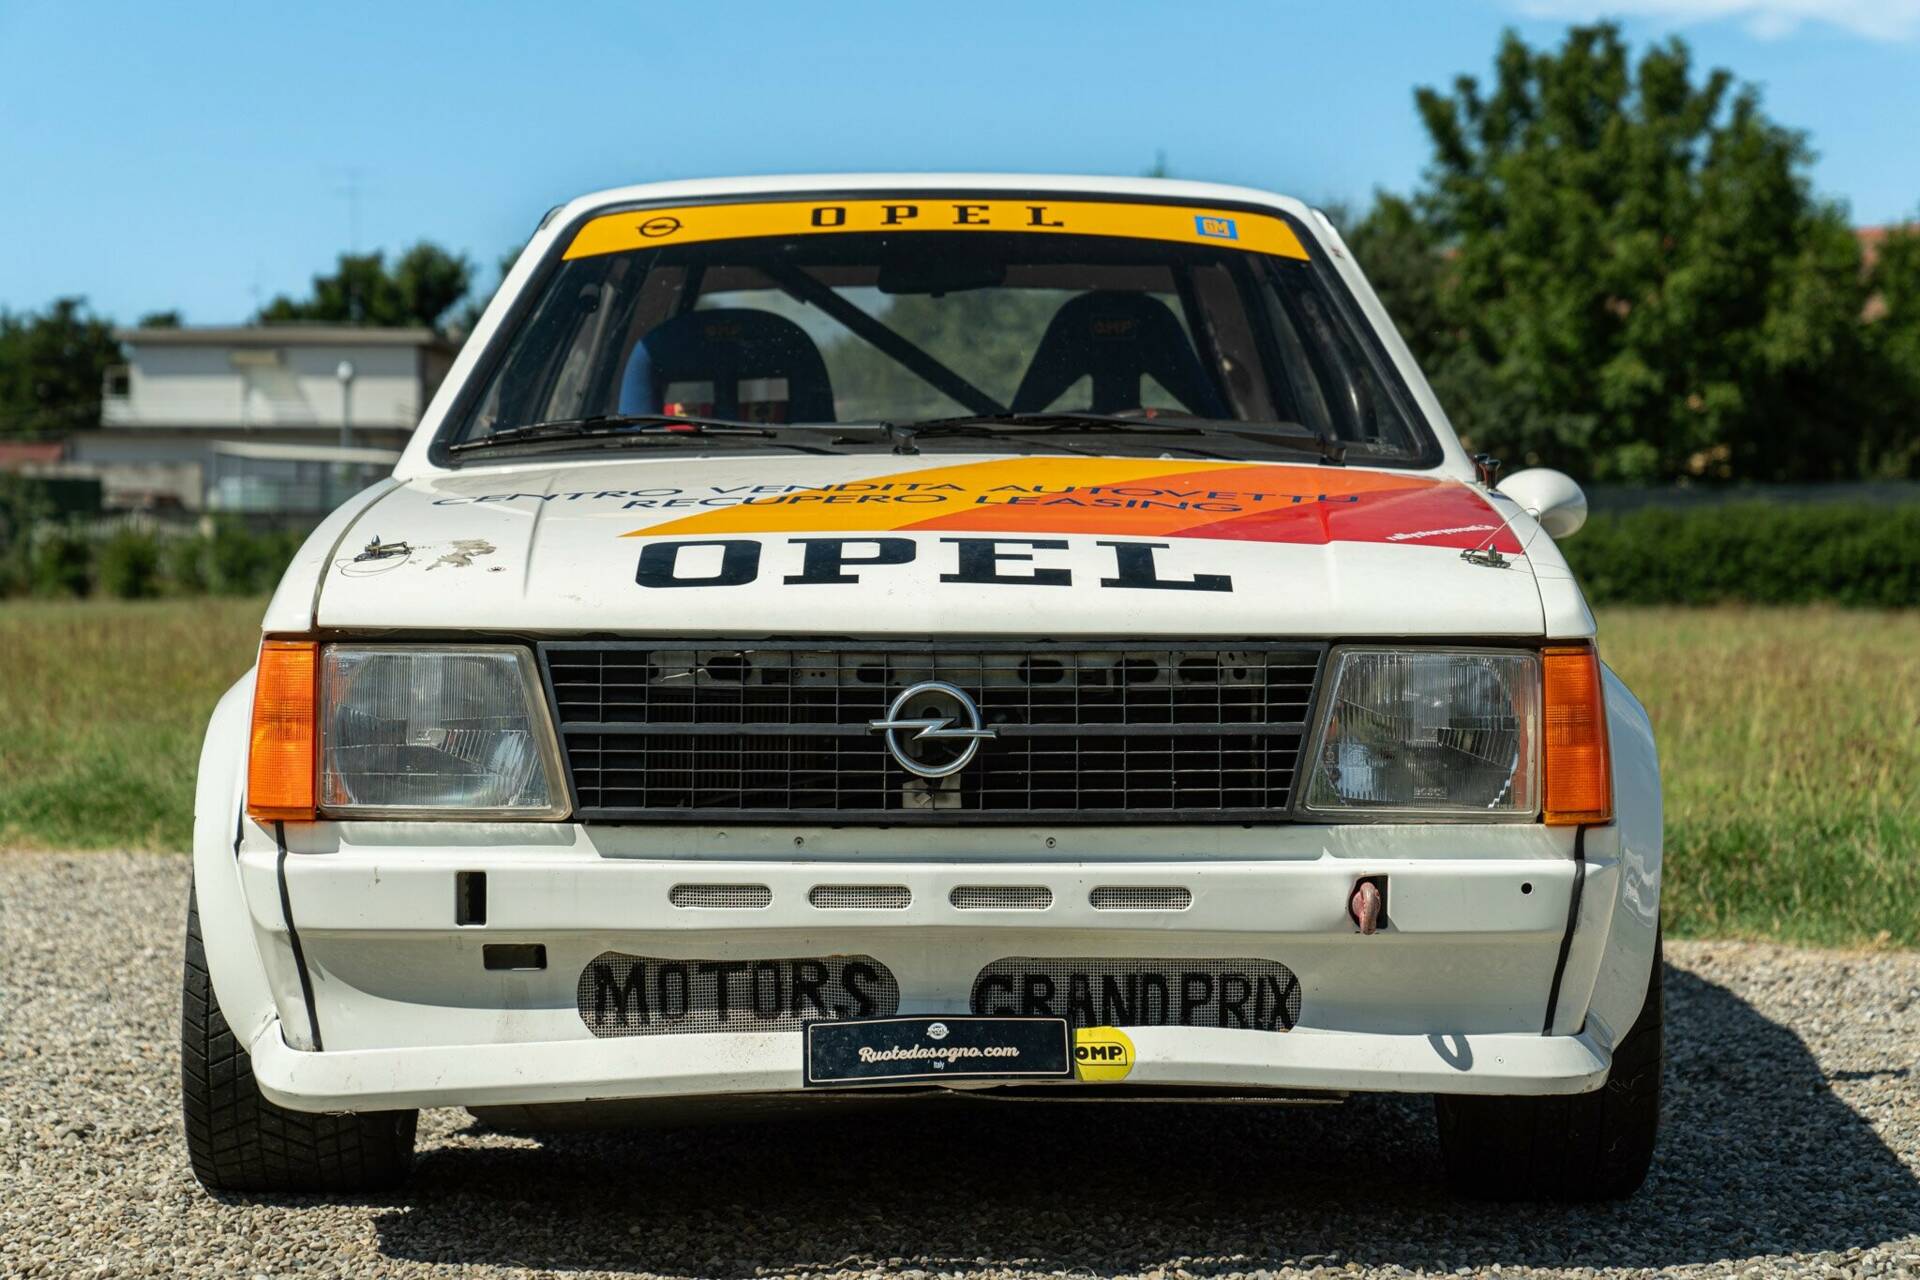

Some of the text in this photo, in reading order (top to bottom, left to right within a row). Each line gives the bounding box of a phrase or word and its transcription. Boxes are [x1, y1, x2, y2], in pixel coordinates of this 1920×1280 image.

[811, 205, 1064, 227] OPEL
[432, 488, 683, 506] CENTRO
[711, 483, 966, 494] VENDITA
[622, 494, 1243, 512] RECUPERO LEASING
[636, 537, 1233, 592] OPEL
[594, 960, 879, 1026] MOTORS
[858, 1043, 1020, 1063] Ruotedasogno.com
[1074, 1046, 1123, 1060] OMP
